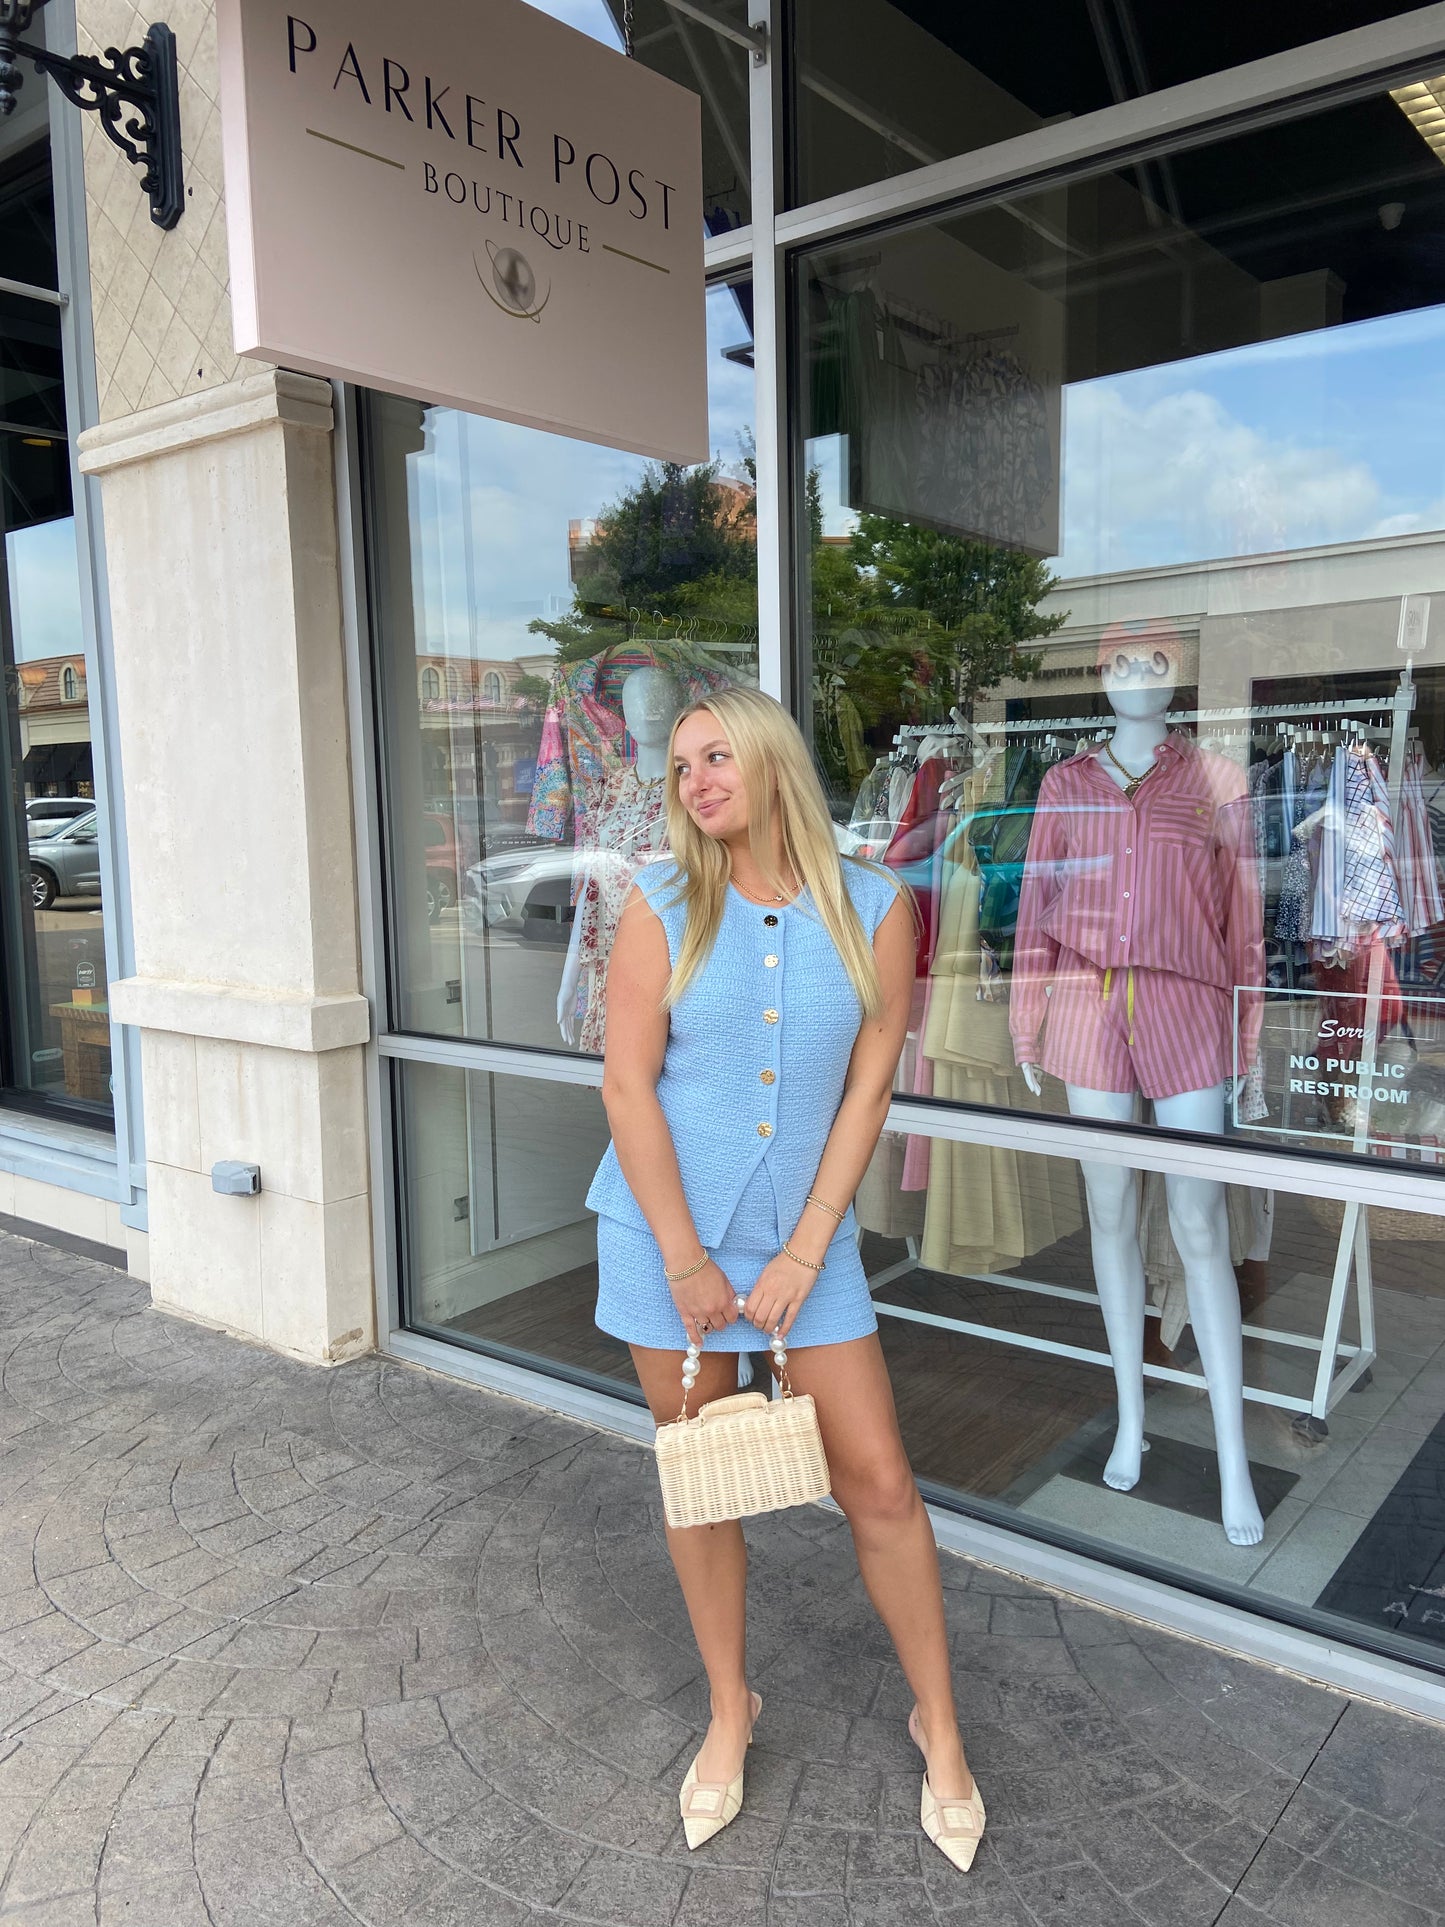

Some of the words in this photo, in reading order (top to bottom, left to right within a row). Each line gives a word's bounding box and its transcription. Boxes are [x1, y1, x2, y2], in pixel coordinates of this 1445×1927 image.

[286, 15, 524, 169] PARKER
[553, 133, 677, 230] POST
[423, 161, 591, 254] BOUTIQUE
[1317, 1019, 1376, 1046] Sorry
[1290, 1054, 1319, 1071] NO
[1326, 1058, 1405, 1079] PUBLIC
[1290, 1078, 1408, 1104] RESTROOM
